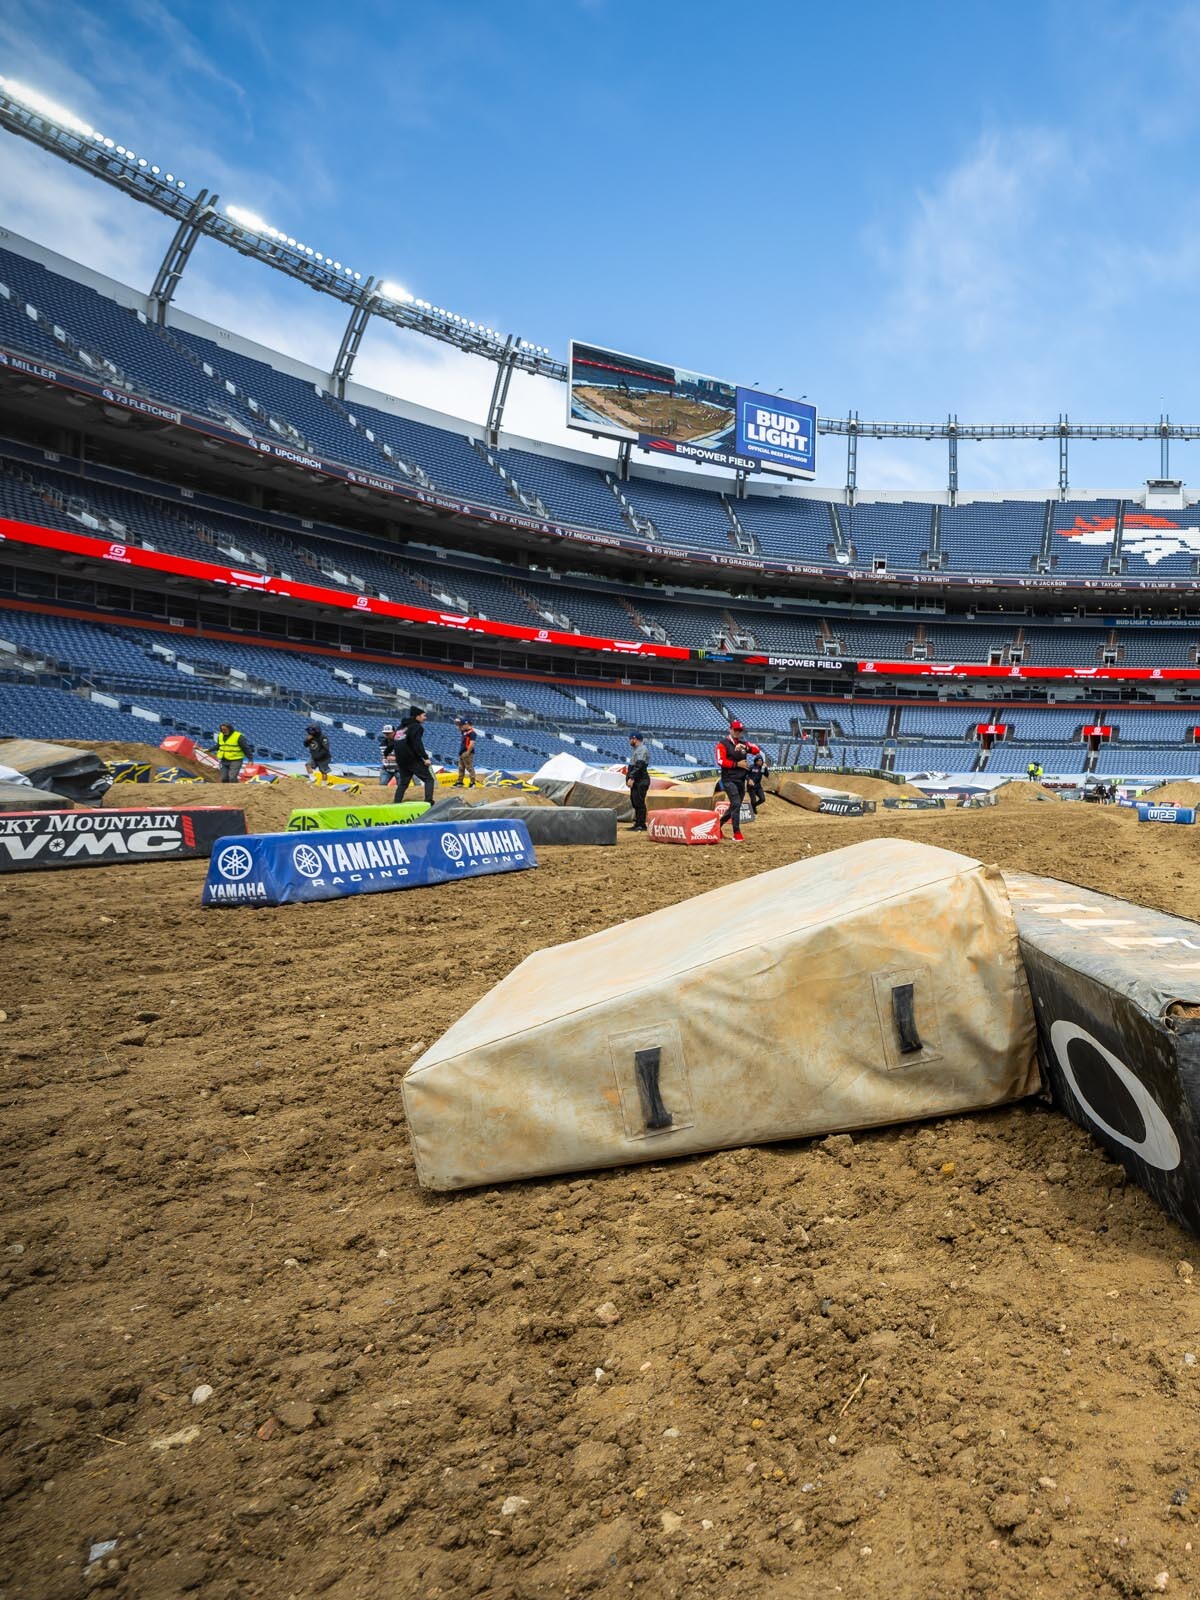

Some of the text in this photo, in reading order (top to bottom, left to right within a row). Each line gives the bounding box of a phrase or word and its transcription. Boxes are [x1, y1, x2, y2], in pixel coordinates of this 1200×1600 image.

[11, 358, 57, 380] MILLER
[116, 393, 177, 421] 73 FLETCHER
[756, 409, 800, 433] BUD
[747, 423, 808, 452] LIGHT
[260, 443, 322, 470] 80 UPCHURCH
[676, 444, 755, 469] EMPOWER FIELD
[369, 477, 394, 491] NALEN
[436, 498, 461, 511] SHARPE
[509, 517, 540, 530] ATWATER
[573, 532, 621, 546] MECKLENBURG
[662, 549, 689, 558] WRIGHT
[729, 558, 764, 568] GRADISHAR
[768, 657, 842, 669] EMPOWER FIELD
[1147, 809, 1177, 821] WPS
[653, 825, 687, 839] HONDA
[458, 830, 525, 856] YAMAHA
[317, 838, 410, 873] YAMAHA
[455, 853, 524, 868] RACING
[312, 868, 409, 887] RACING
[208, 882, 267, 899] YAMAHA
